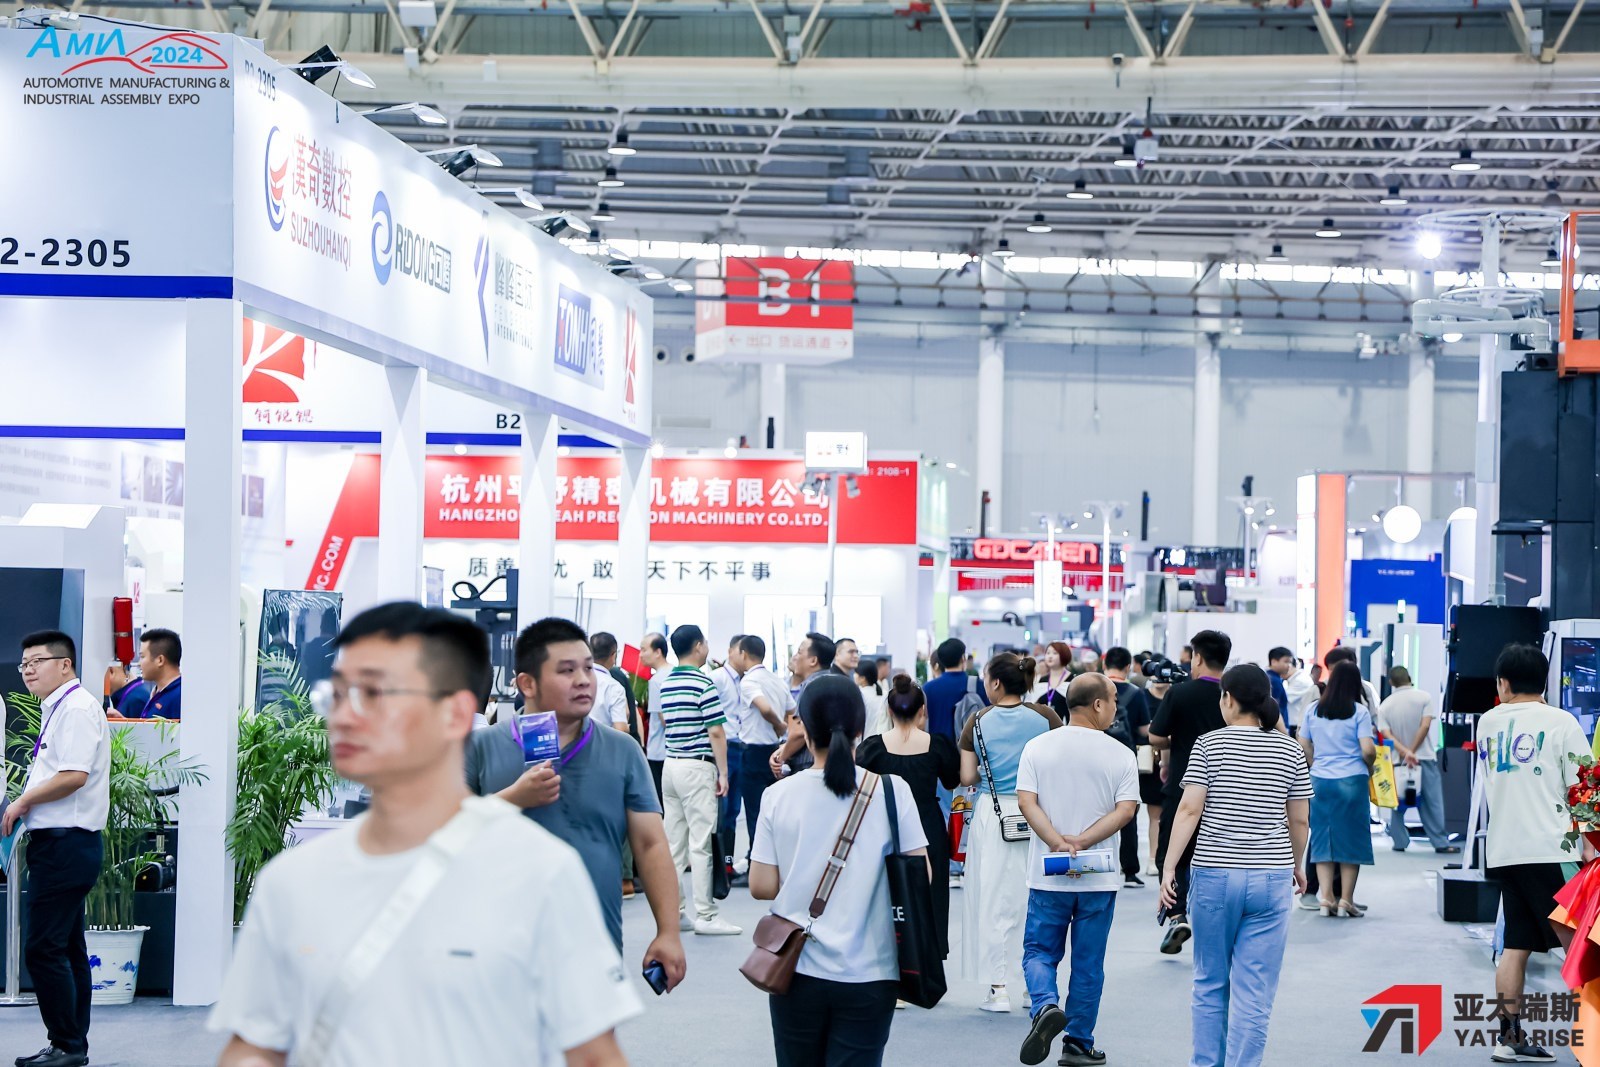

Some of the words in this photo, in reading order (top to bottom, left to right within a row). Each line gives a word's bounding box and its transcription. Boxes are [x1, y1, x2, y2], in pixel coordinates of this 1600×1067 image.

[290, 211, 351, 272] SUZHOUHANQI
[758, 267, 821, 318] B1
[439, 508, 521, 523] HANGZHO
[673, 511, 764, 525] MACHINERY
